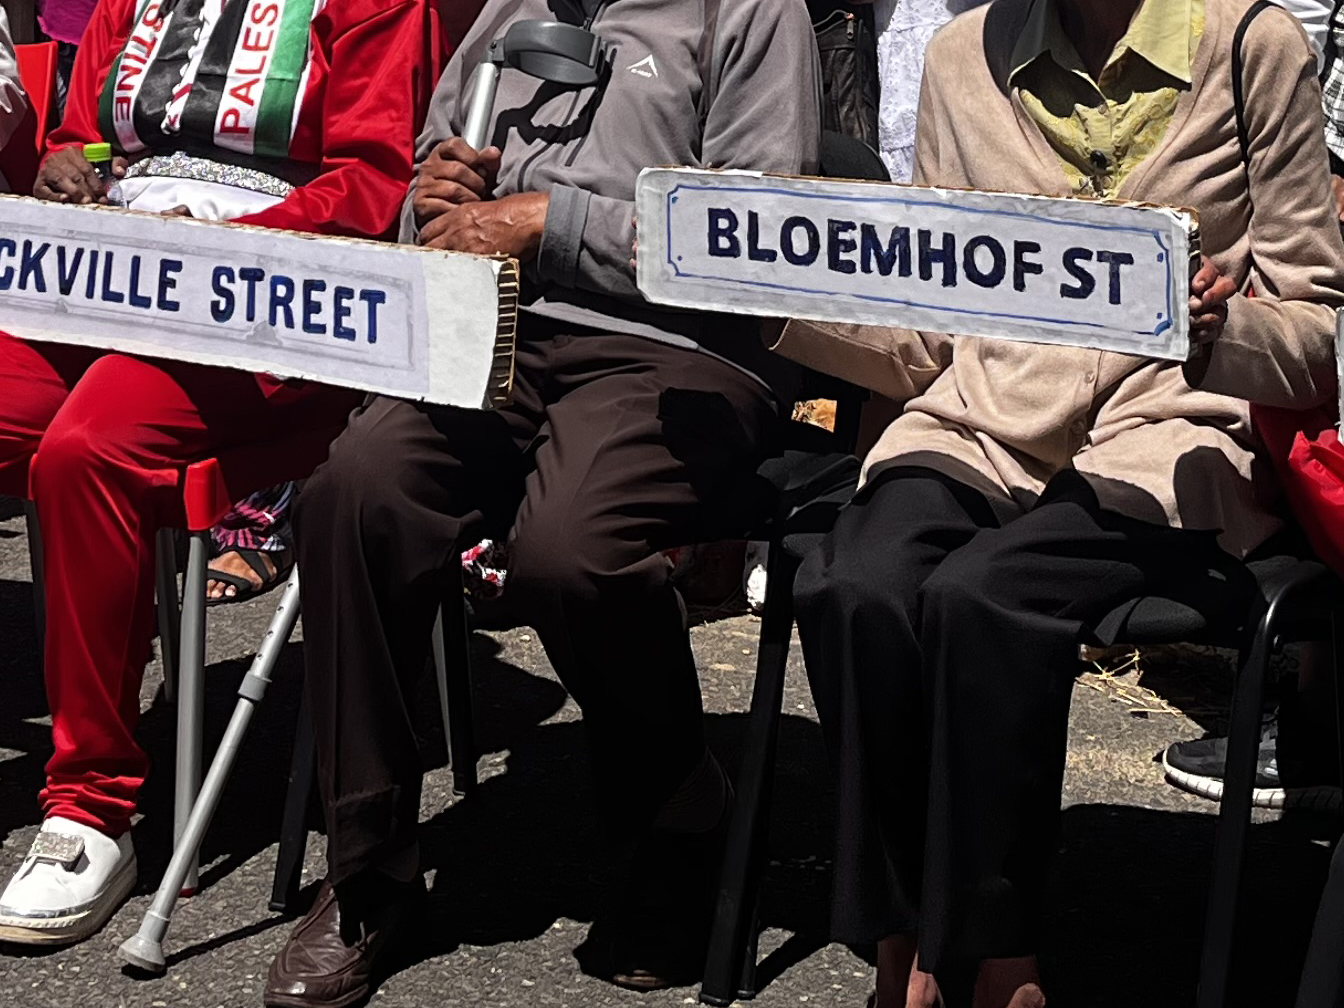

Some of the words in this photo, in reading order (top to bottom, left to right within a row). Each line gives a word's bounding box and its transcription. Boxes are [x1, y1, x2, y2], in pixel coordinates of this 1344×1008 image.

[707, 207, 1044, 292] BLOEMHOF
[1060, 246, 1134, 305] ST
[210, 265, 386, 344] STREET
